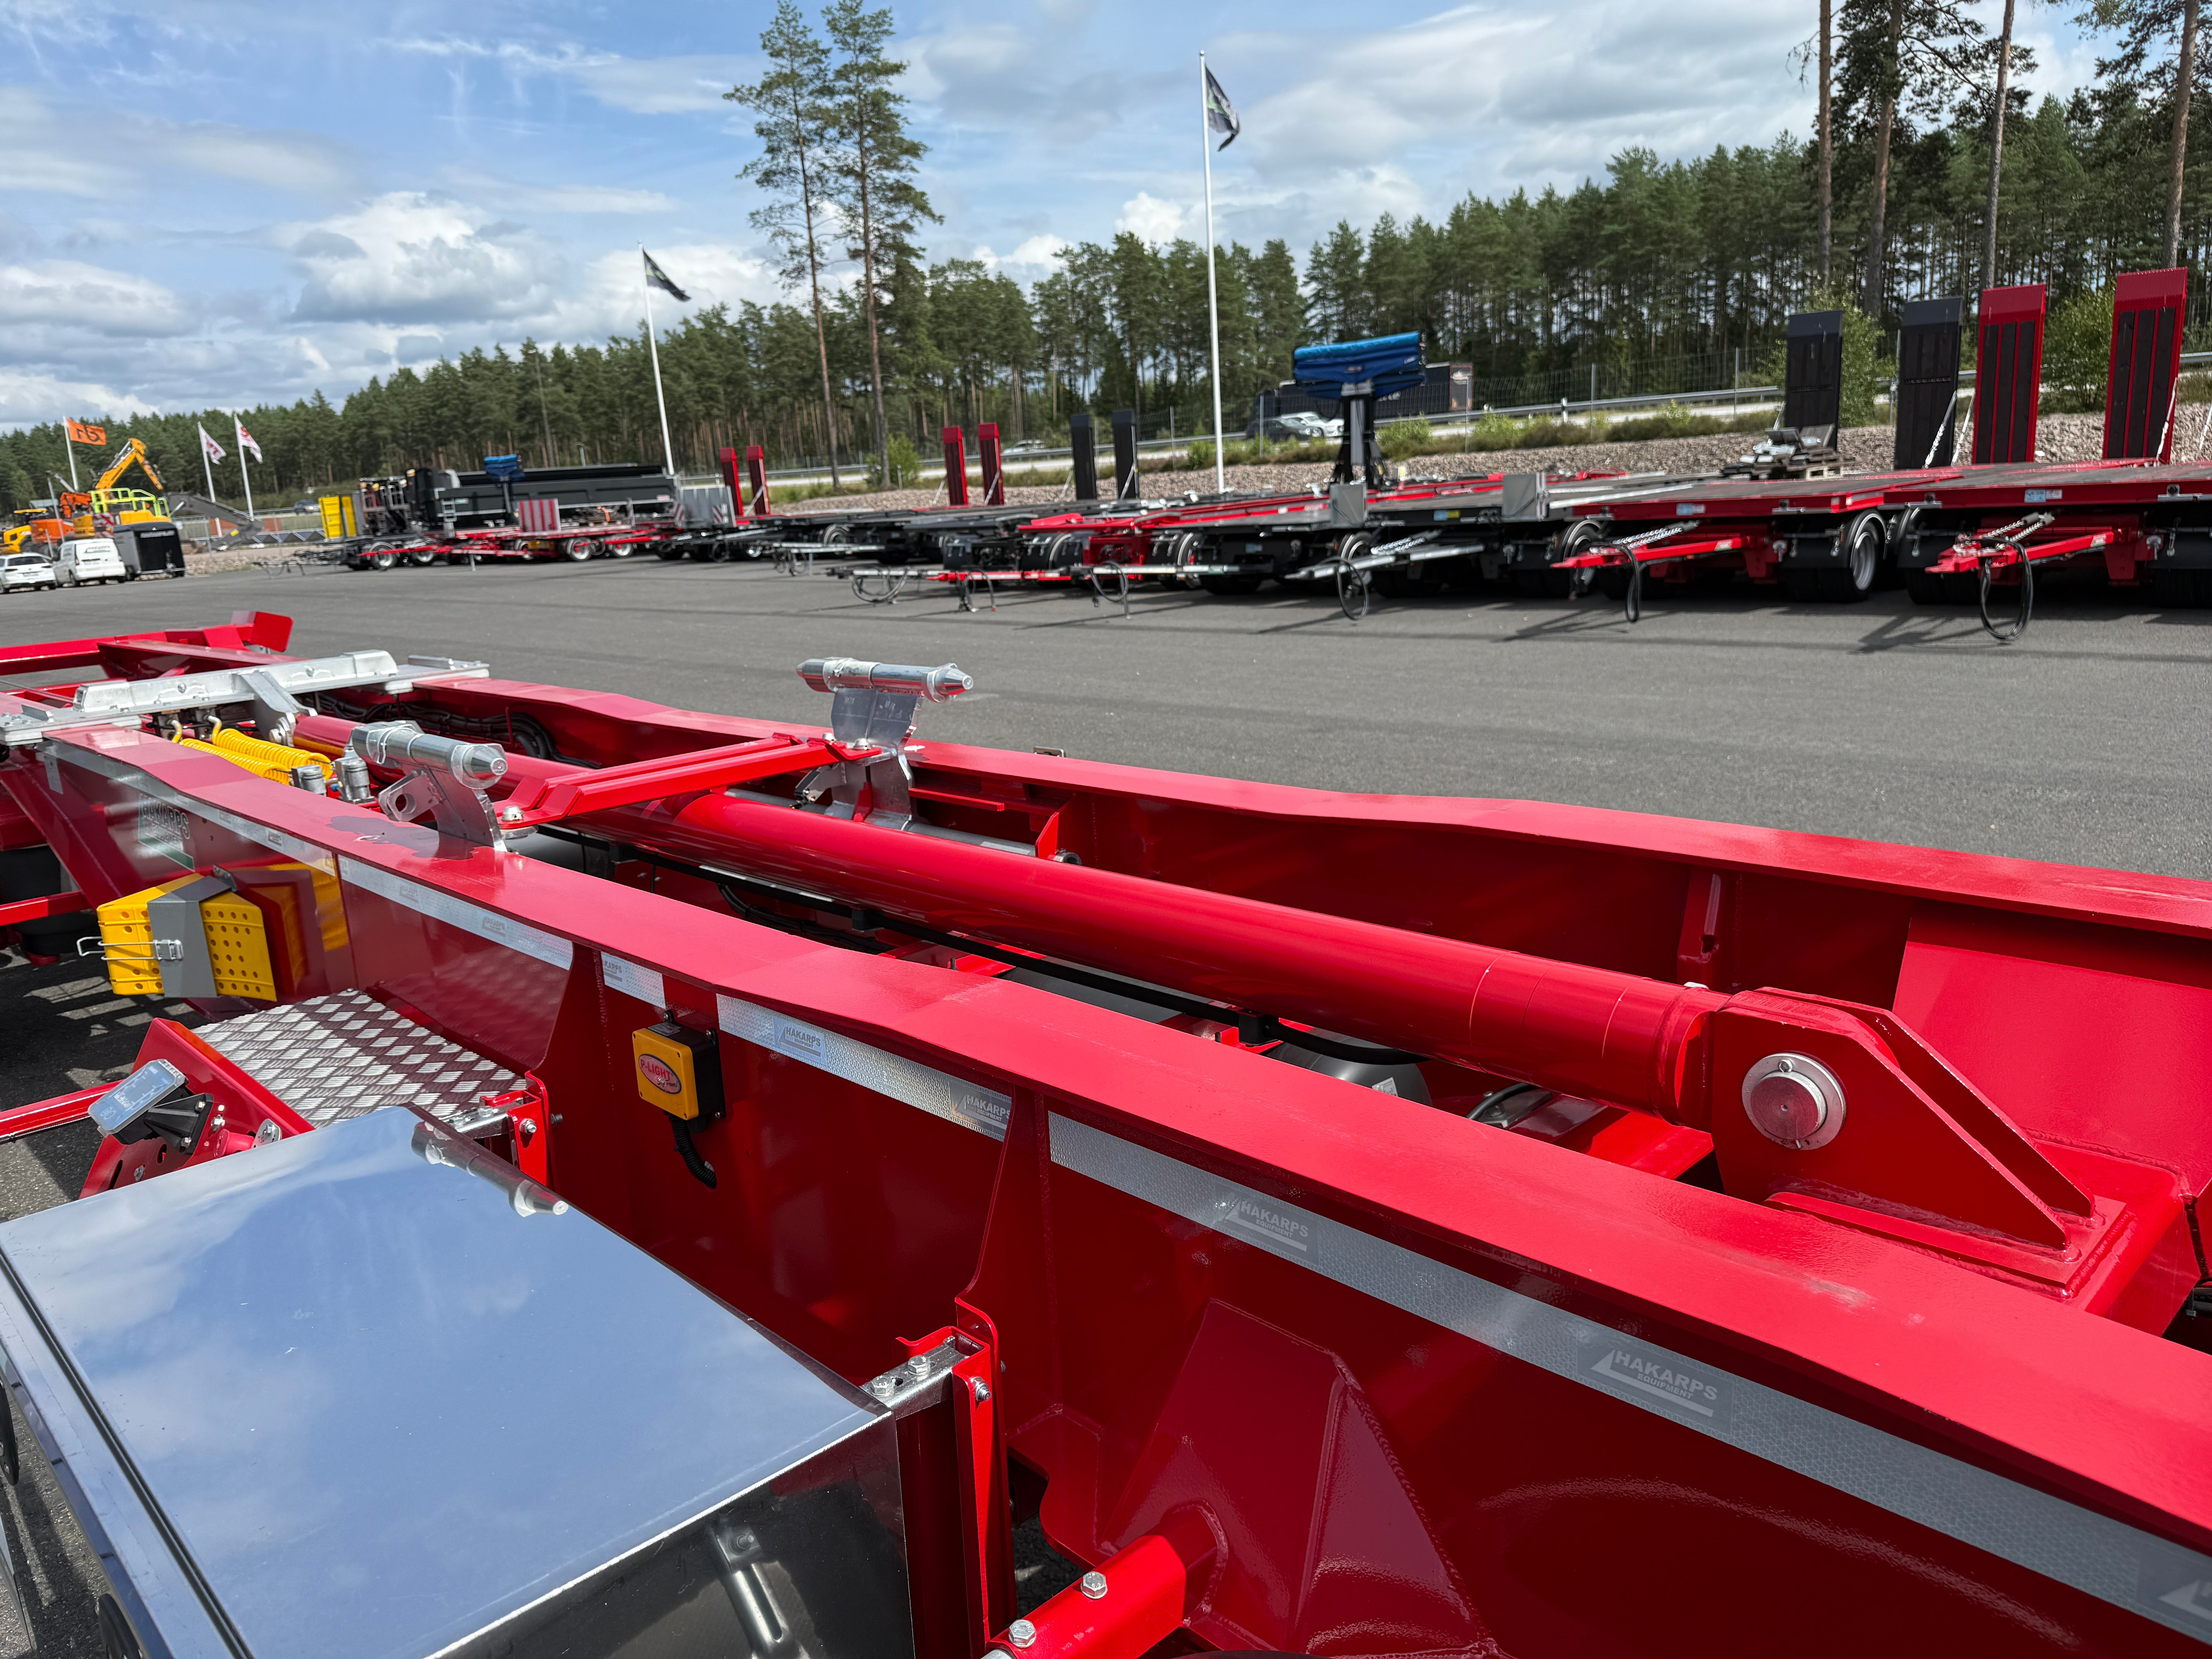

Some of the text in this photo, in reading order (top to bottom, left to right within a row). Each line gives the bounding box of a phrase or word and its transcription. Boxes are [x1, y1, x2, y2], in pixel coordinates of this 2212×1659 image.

[786, 1027, 821, 1047] HAKARPS
[640, 1058, 670, 1080] P-LIGHT
[977, 1108, 1002, 1121] EQUIPMENT
[1240, 1201, 1309, 1237] HAKARPS
[1256, 1219, 1293, 1238] EQUIPMENT
[1614, 1350, 1717, 1400] HAKARPS
[1637, 1372, 1693, 1399] EQUIPMENT
